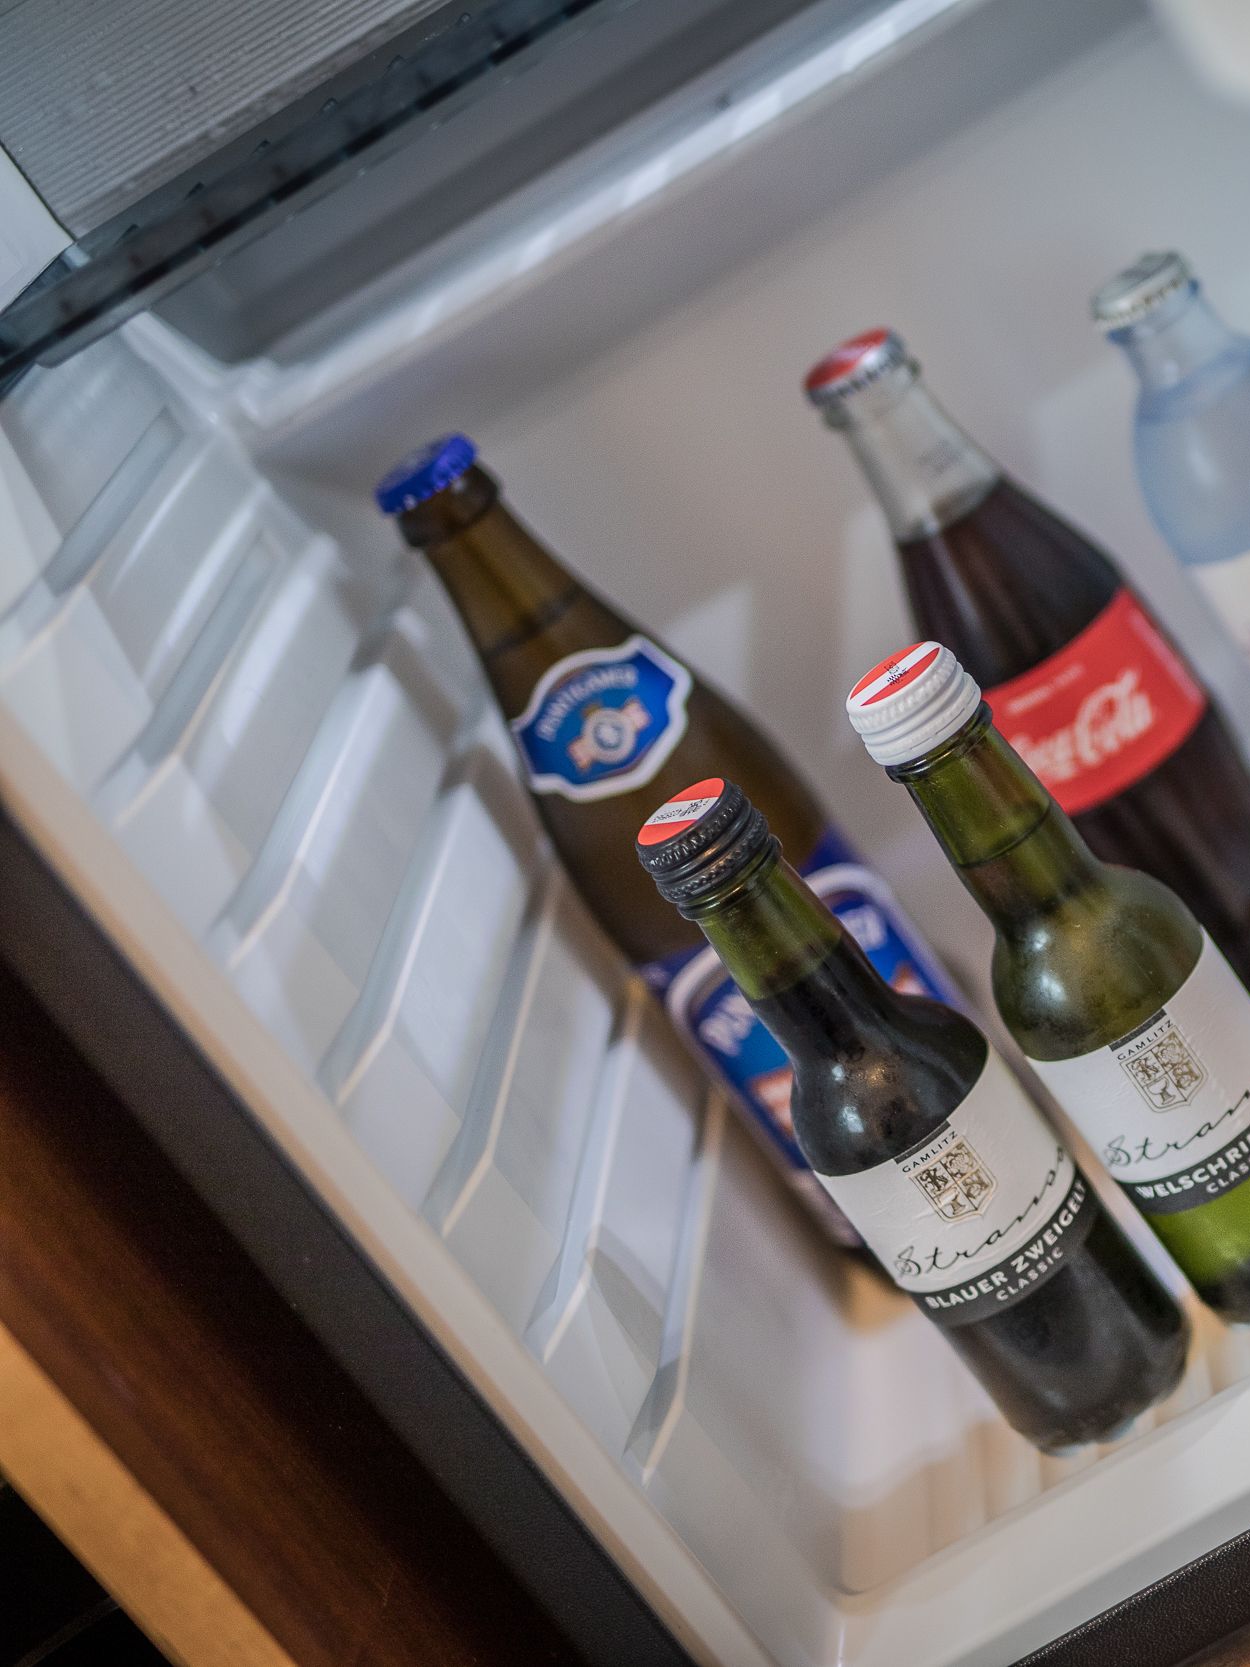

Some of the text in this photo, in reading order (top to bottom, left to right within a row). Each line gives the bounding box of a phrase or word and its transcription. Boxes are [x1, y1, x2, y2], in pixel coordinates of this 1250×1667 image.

[1116, 1018, 1174, 1062] GAMLITZ
[902, 1130, 958, 1174] GAMLITZ
[924, 1180, 1087, 1311] BLAUER ZWEIGELT
[995, 1245, 1065, 1302] CLASSIC
